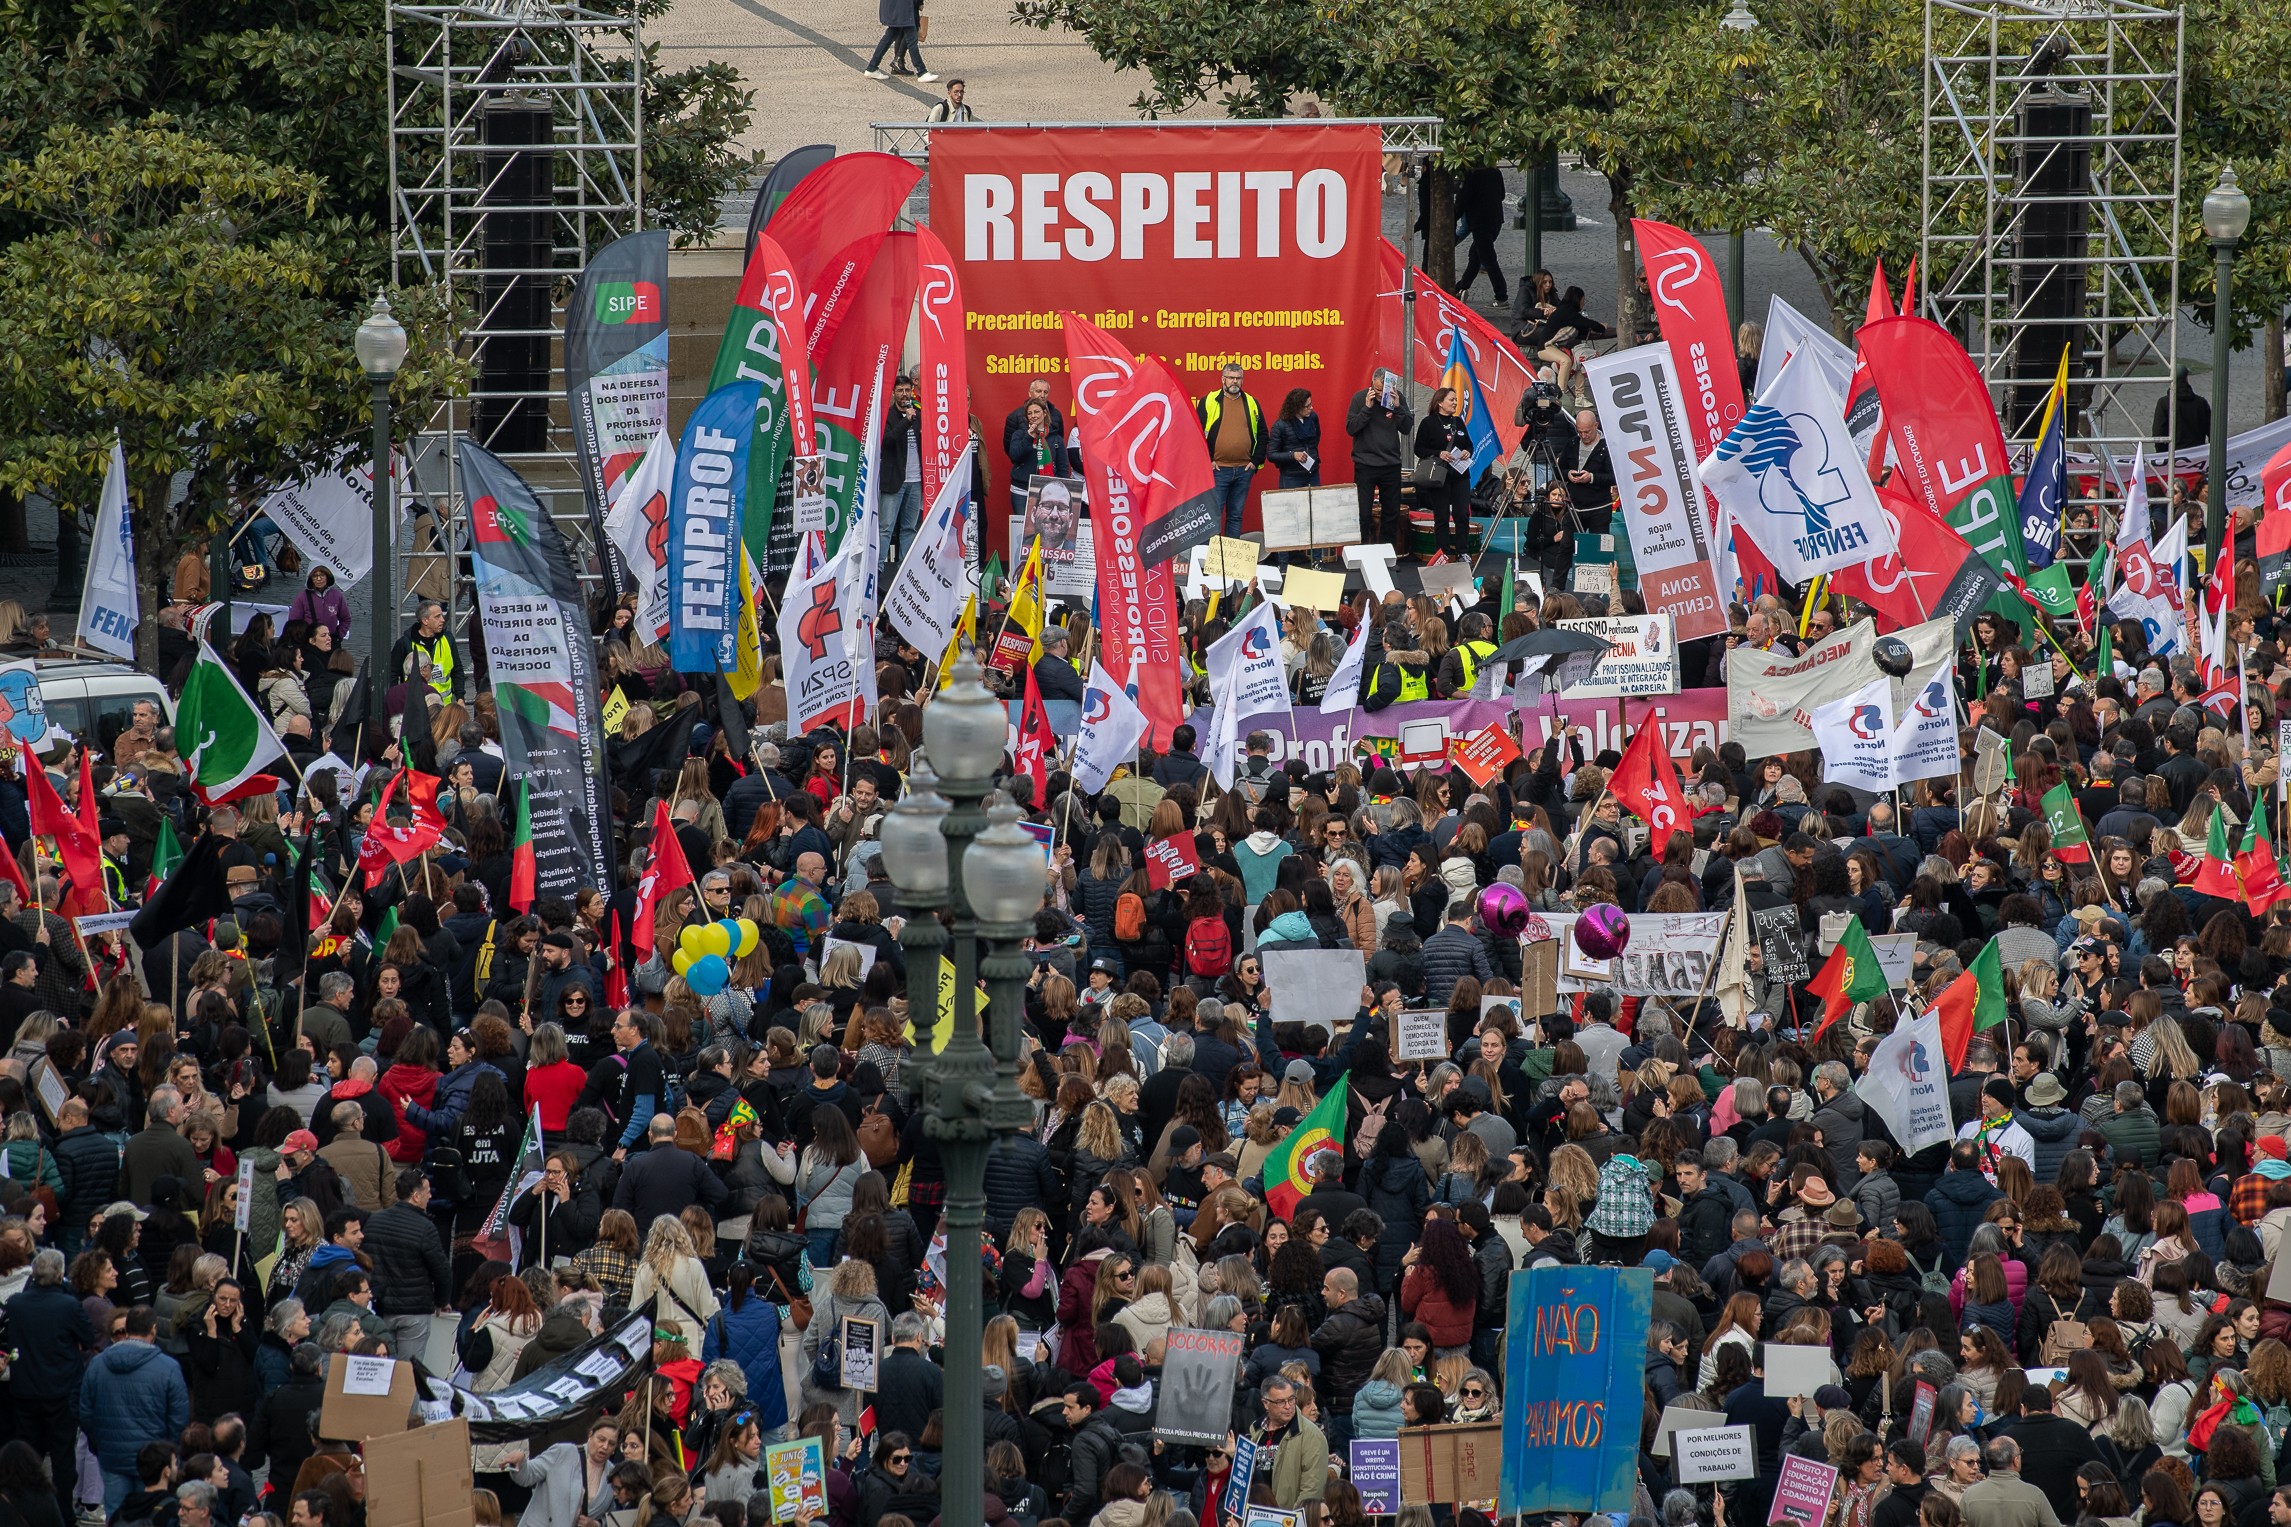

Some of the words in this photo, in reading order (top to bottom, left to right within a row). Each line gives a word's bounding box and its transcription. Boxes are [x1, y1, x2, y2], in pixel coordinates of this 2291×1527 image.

[964, 169, 1347, 261] RESPEITO
[825, 260, 856, 312] EDUCADORES
[609, 295, 648, 312] SIPE
[1095, 309, 1134, 329] não!
[1156, 309, 1230, 328] Carreira
[1234, 308, 1345, 328] recomposta.
[986, 354, 1060, 374] Salários
[1185, 352, 1262, 372] Horários
[1265, 351, 1325, 372] legais.
[602, 382, 617, 391] NA
[620, 379, 660, 390] DEFESA
[597, 396, 619, 405] DOS
[621, 391, 666, 403] DIREITOS
[626, 407, 640, 416] DA
[582, 391, 598, 453] Educadores
[606, 417, 662, 430] PROFISSÃO
[615, 430, 660, 443] DOCENTE
[286, 492, 320, 530] Sindicato
[320, 529, 336, 545] dos
[682, 425, 737, 630] FENPROF
[277, 501, 319, 547] Professores
[319, 545, 331, 558] do
[330, 556, 354, 580] Norte
[723, 587, 731, 631] Federação
[728, 494, 736, 540] Professores
[906, 569, 930, 603] Sindicato
[1579, 582, 1600, 591] LUTA
[896, 603, 913, 628] Norte
[898, 584, 908, 598] dos
[907, 594, 943, 639] Professores
[1608, 624, 1639, 635] PORTUGUESA
[1000, 636, 1032, 653] RESPEITO
[1602, 661, 1671, 676] PROFISSIONALIZADOS
[1628, 672, 1667, 683] INTEGRAÇÃO
[1620, 686, 1629, 694] NA
[1631, 684, 1667, 694] CARREIRA
[1169, 859, 1182, 867] PARA
[1172, 866, 1193, 876] ENSINAR
[475, 1139, 491, 1148] em
[1534, 1287, 1600, 1357] NÃO
[1167, 1331, 1242, 1360] SOCORRO
[1175, 1429, 1192, 1437] PÚBLICA
[1525, 1401, 1605, 1450] PARAMOS
[1704, 1433, 1742, 1442] MELHORES
[780, 1449, 808, 1463] JUNTOS
[1690, 1448, 1728, 1458] CONDIÇÕES
[1354, 1472, 1369, 1480] NÃO
[1371, 1471, 1375, 1479] É
[1699, 1463, 1736, 1472] TRABALHO
[1792, 1461, 1821, 1476] DIREITO
[1822, 1468, 1828, 1477] À
[1787, 1470, 1829, 1488] EDUCAÇÃO
[1784, 1478, 1788, 1486] É
[1790, 1480, 1819, 1494] DIREITO
[1820, 1487, 1826, 1497] À
[1781, 1489, 1823, 1506] CIDADANIA
[1786, 1508, 1808, 1519] Respeito
